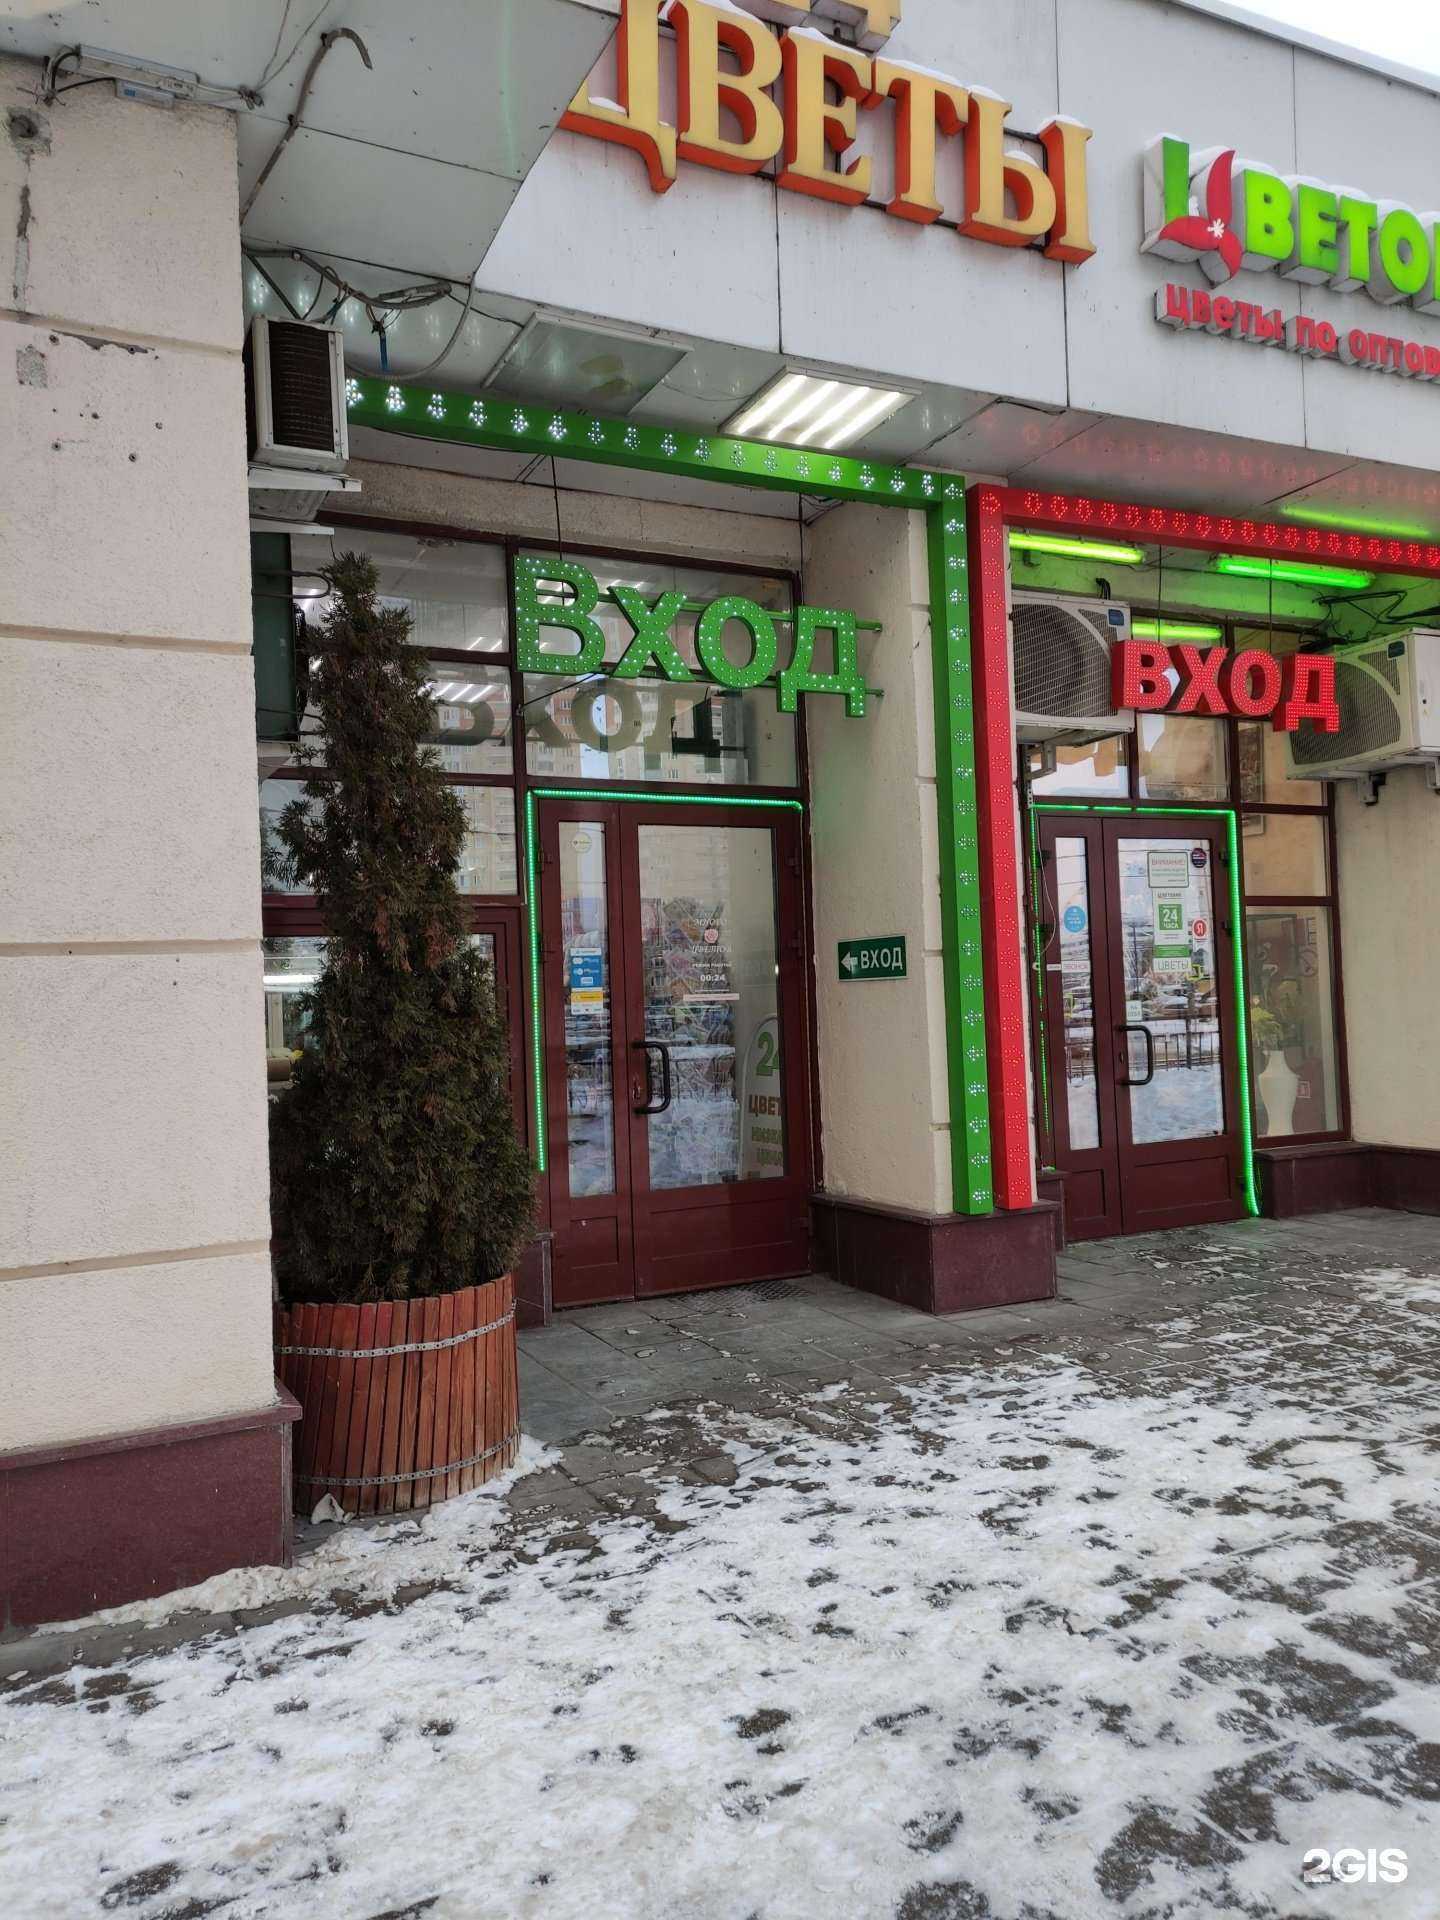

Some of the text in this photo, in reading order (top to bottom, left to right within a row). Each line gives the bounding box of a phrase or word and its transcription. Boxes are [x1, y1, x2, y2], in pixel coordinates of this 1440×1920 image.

[1156, 136, 1440, 299] ЦВЕТО
[1121, 639, 1341, 733] ВХОД
[1163, 909, 1178, 922] 24
[860, 946, 903, 971] ВХОД
[1157, 960, 1189, 971] ЦВЕТЫ
[700, 973, 726, 983] 00:24
